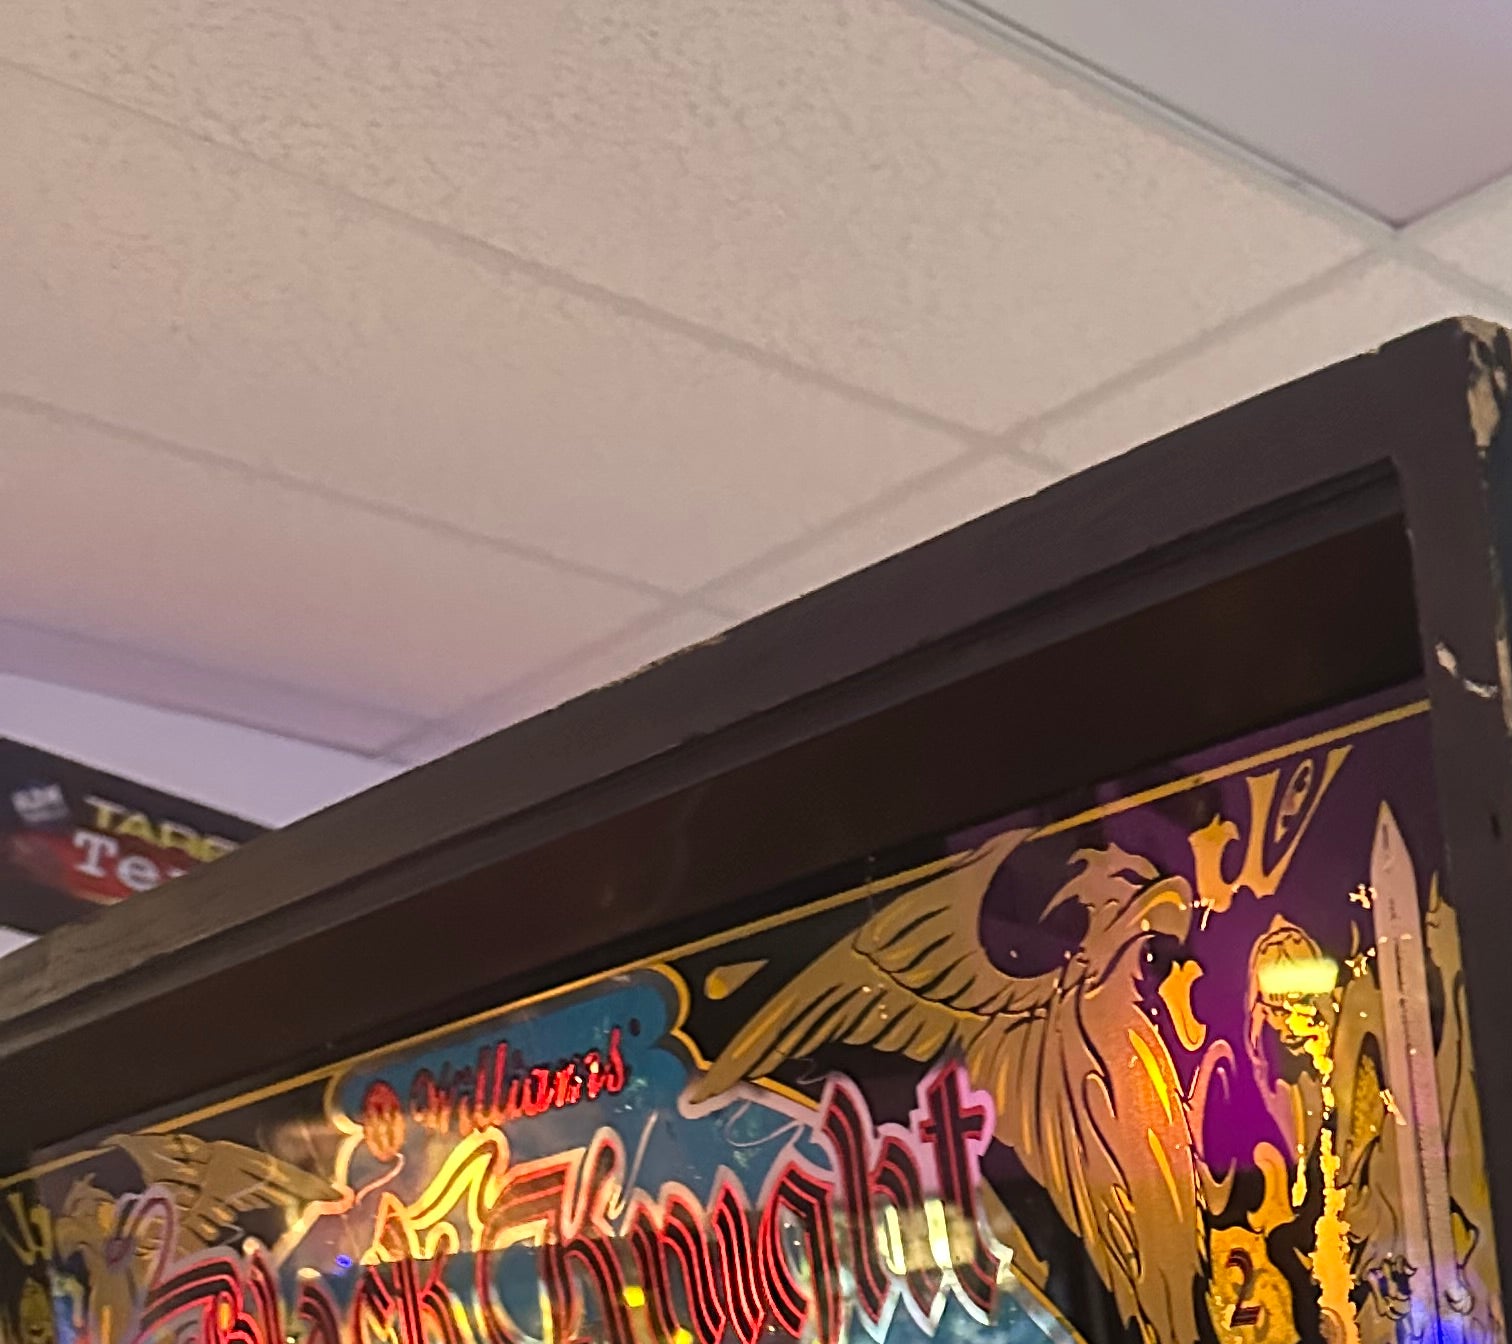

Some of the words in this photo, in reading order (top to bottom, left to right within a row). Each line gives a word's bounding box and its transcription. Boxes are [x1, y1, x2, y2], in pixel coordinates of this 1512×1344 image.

[73, 830, 189, 892] Te
[410, 1026, 625, 1137] Williams
[1226, 1247, 1261, 1328] 2
